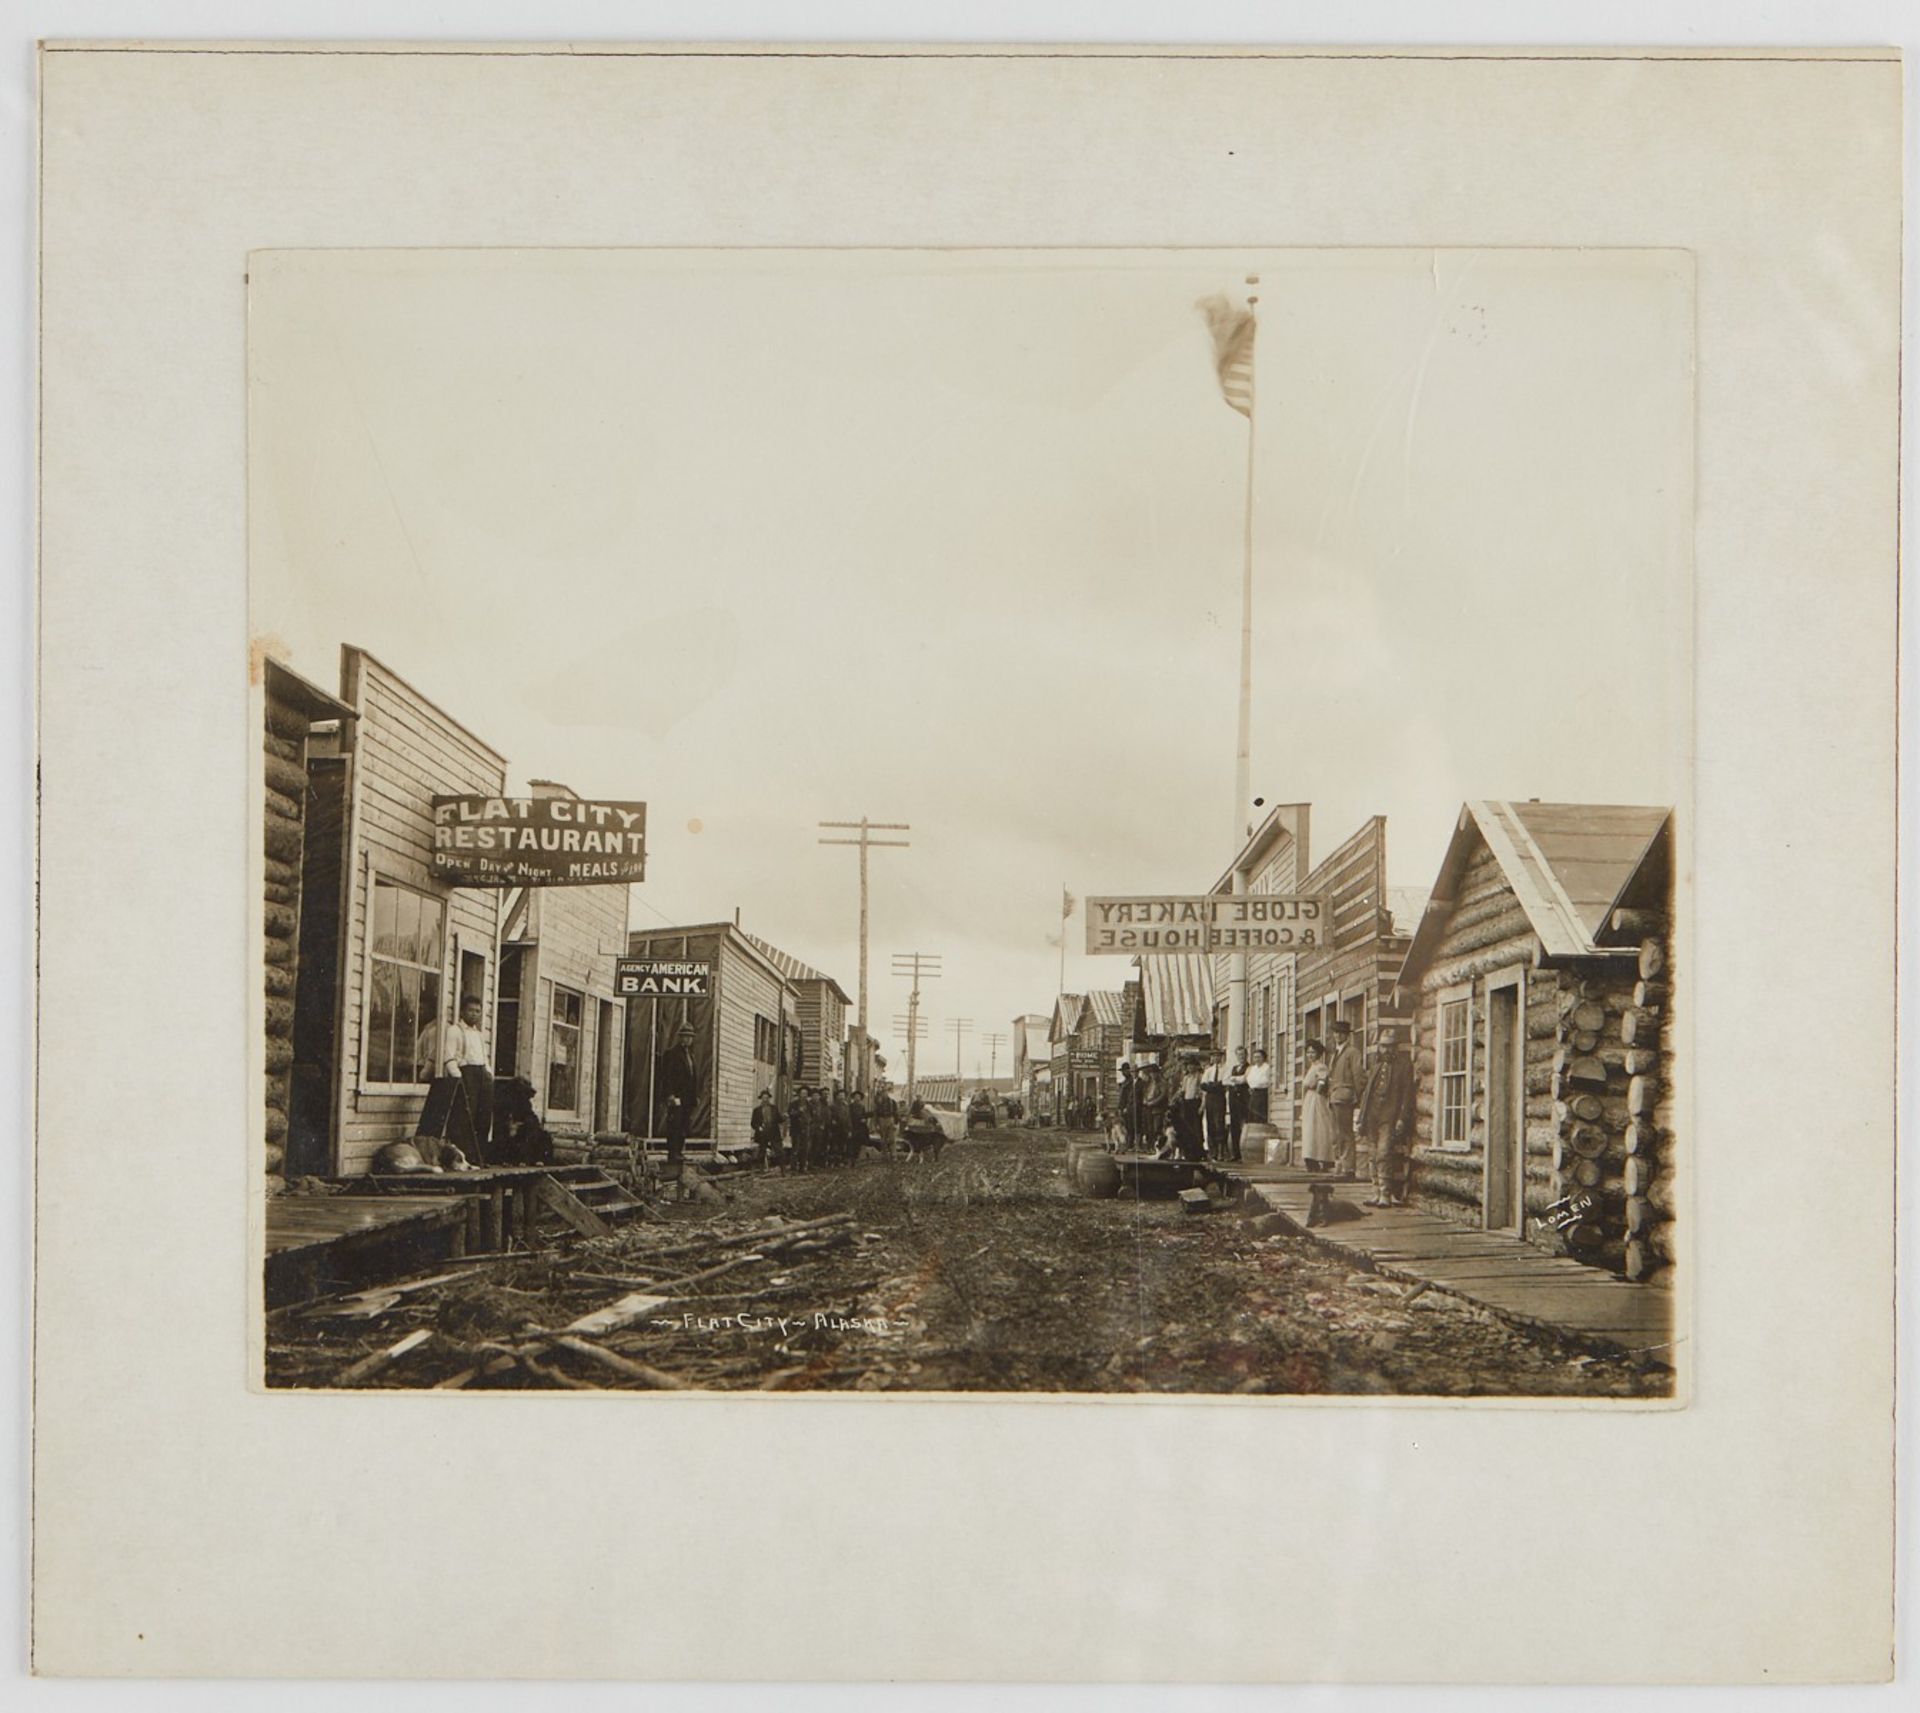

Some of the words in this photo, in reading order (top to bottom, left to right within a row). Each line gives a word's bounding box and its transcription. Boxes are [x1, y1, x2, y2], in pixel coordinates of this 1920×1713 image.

[436, 799, 533, 825] FLAT
[550, 801, 640, 829] CITY
[435, 826, 644, 855] RESTAURANT
[569, 861, 619, 877] MEALS
[620, 964, 652, 974] AGENCY
[650, 963, 709, 976] AMERICAN
[621, 976, 707, 994] BANK.
